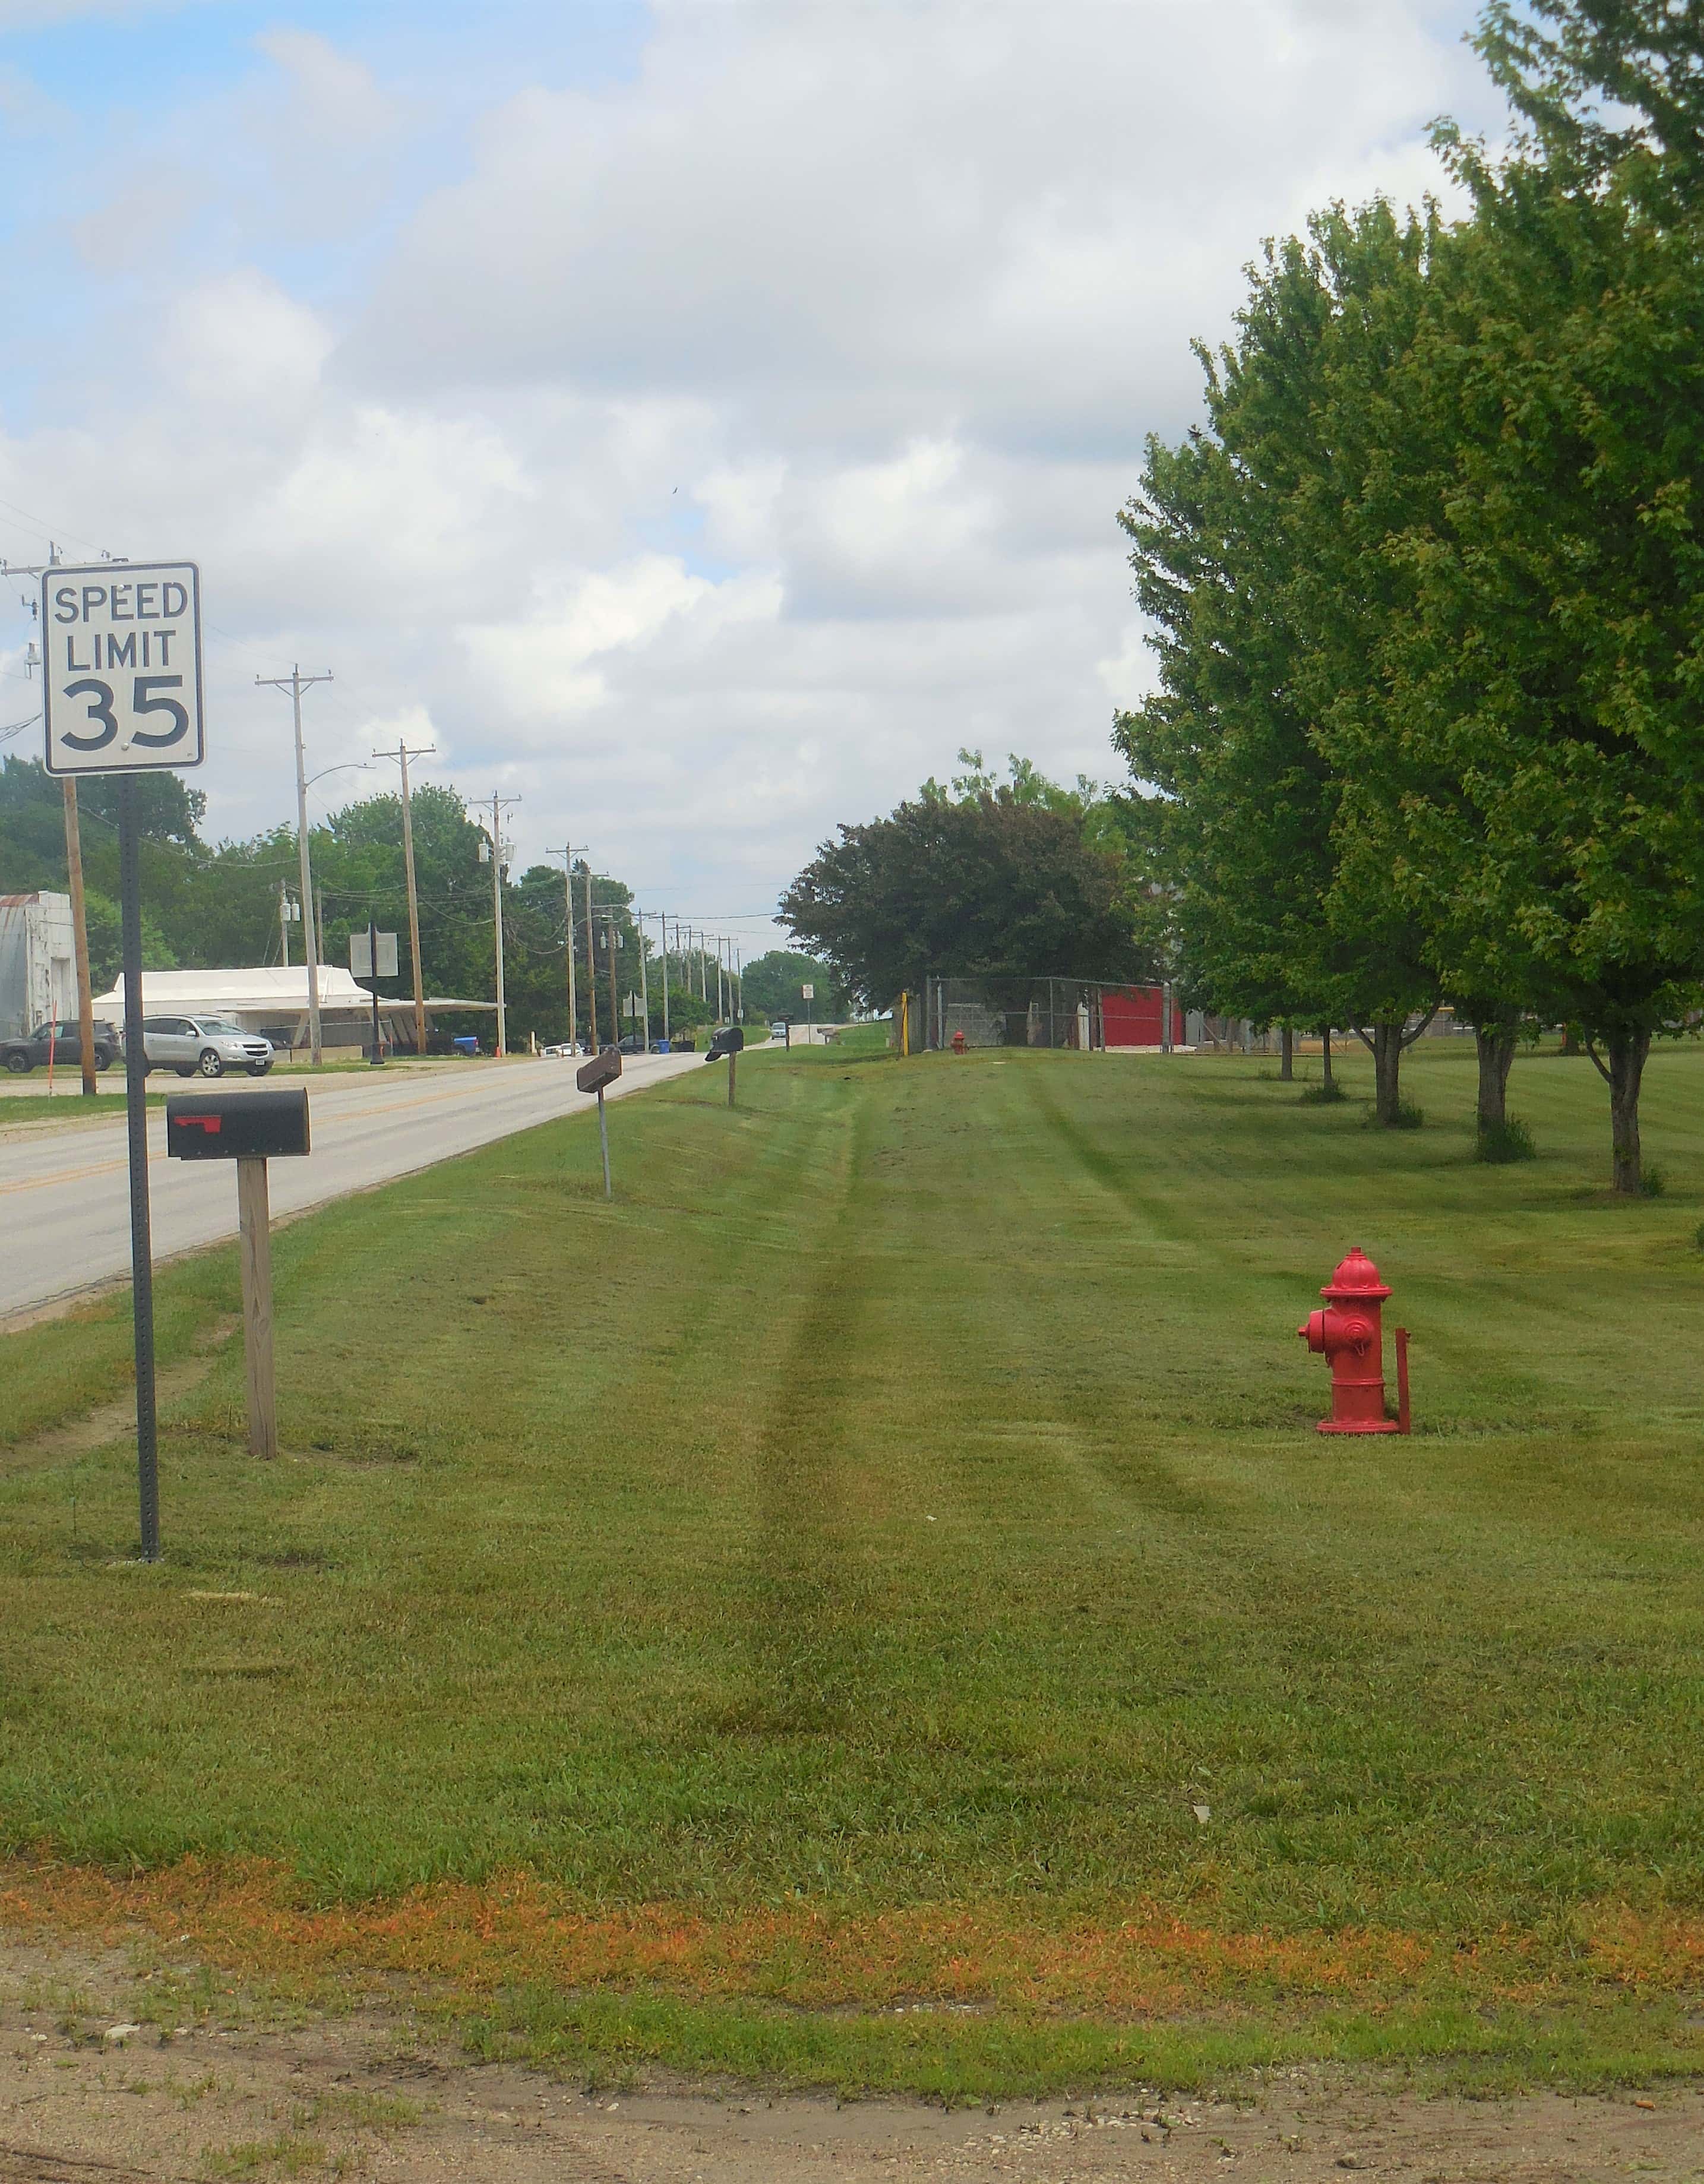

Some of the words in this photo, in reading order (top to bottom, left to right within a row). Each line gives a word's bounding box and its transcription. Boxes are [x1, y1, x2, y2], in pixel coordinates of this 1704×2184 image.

[55, 583, 187, 623] SPEED
[68, 630, 176, 671] LIMIT
[61, 675, 189, 751] 35
